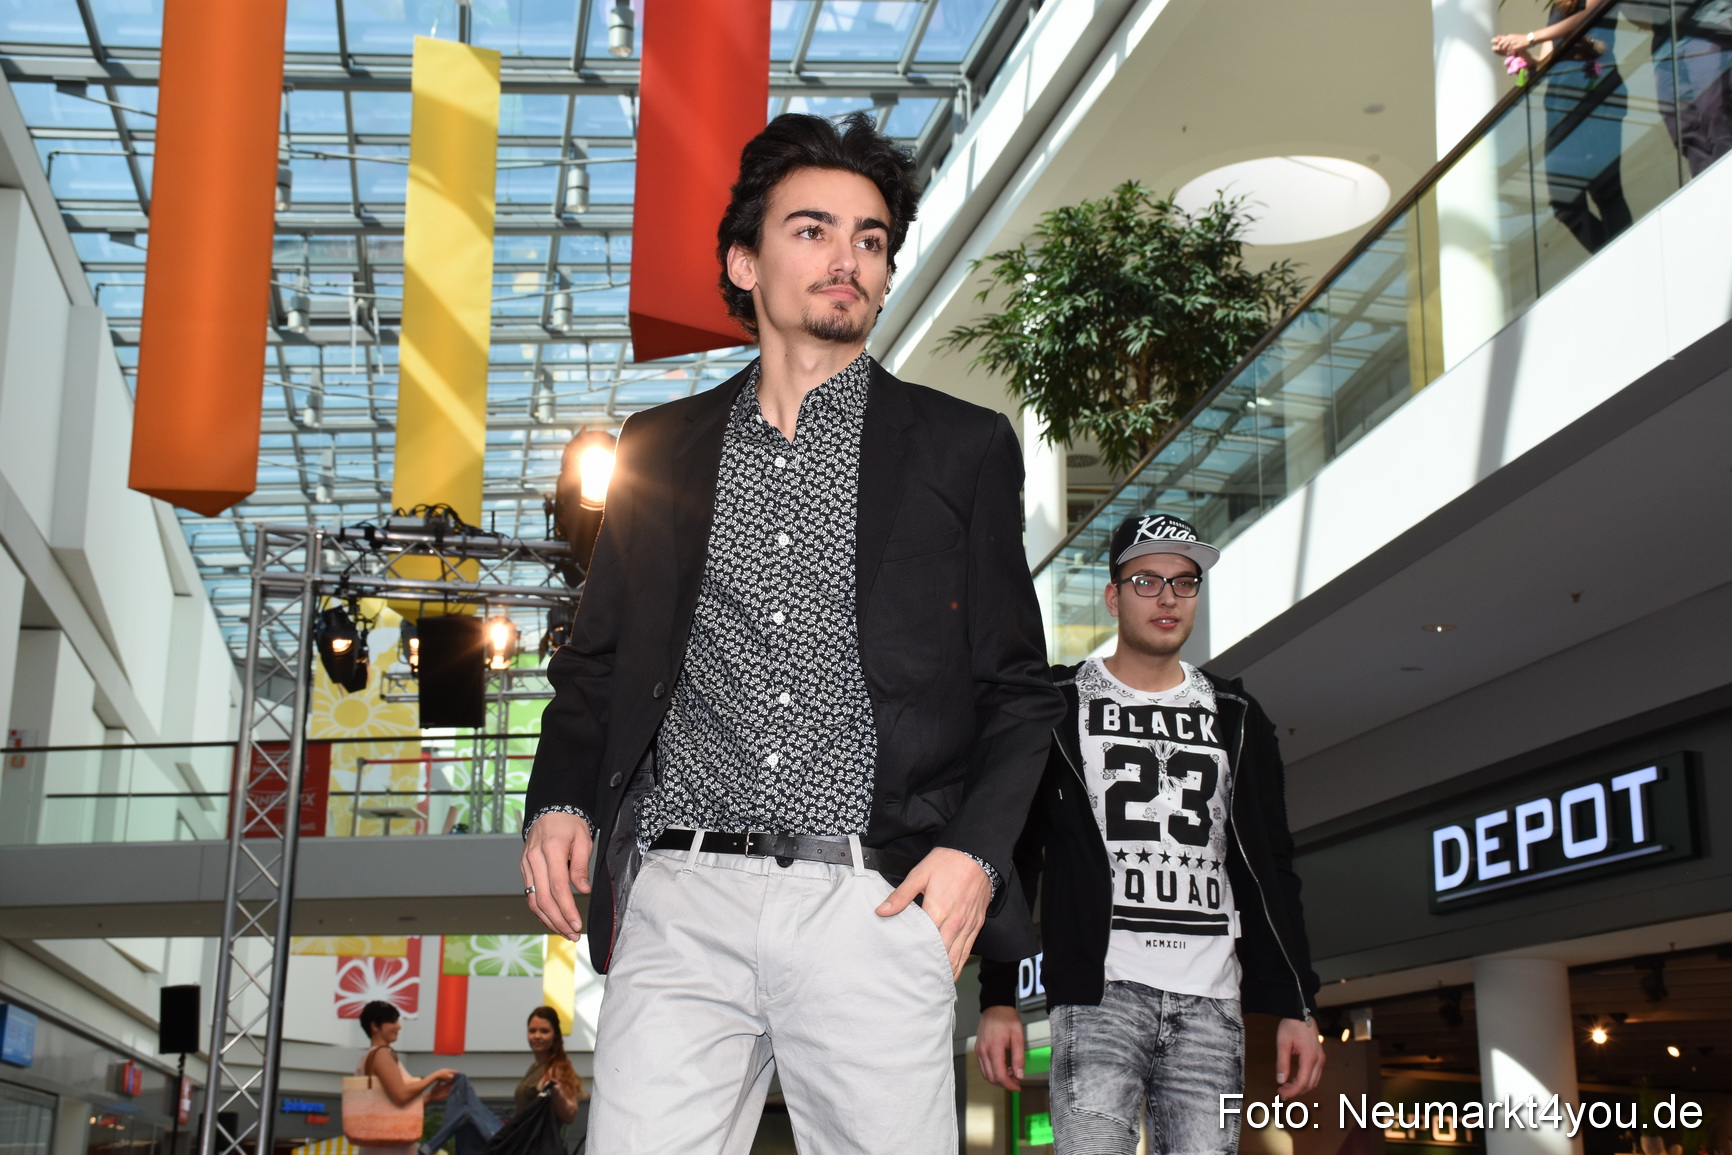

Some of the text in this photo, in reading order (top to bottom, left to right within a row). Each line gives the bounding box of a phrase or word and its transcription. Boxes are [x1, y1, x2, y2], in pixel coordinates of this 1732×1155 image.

[1103, 703, 1218, 743] BLACK
[1104, 743, 1219, 848] 23
[1433, 766, 1658, 891] DEPOT
[1145, 939, 1186, 949] MCMXCII
